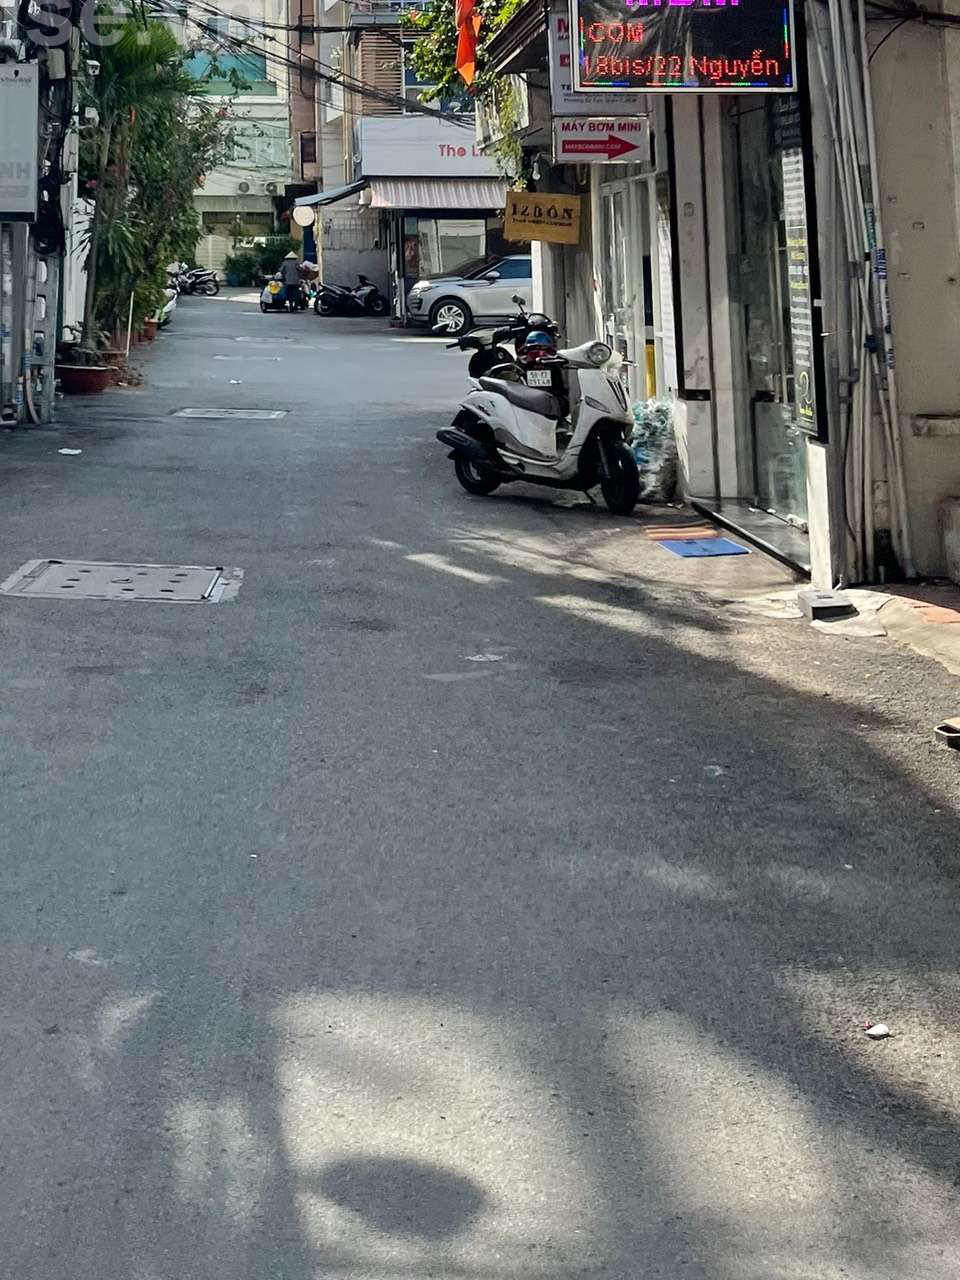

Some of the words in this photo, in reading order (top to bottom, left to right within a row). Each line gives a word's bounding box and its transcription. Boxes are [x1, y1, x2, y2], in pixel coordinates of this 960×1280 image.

[688, 48, 779, 80] Nguyễn
[618, 122, 641, 132] MINI
[438, 144, 467, 157] The
